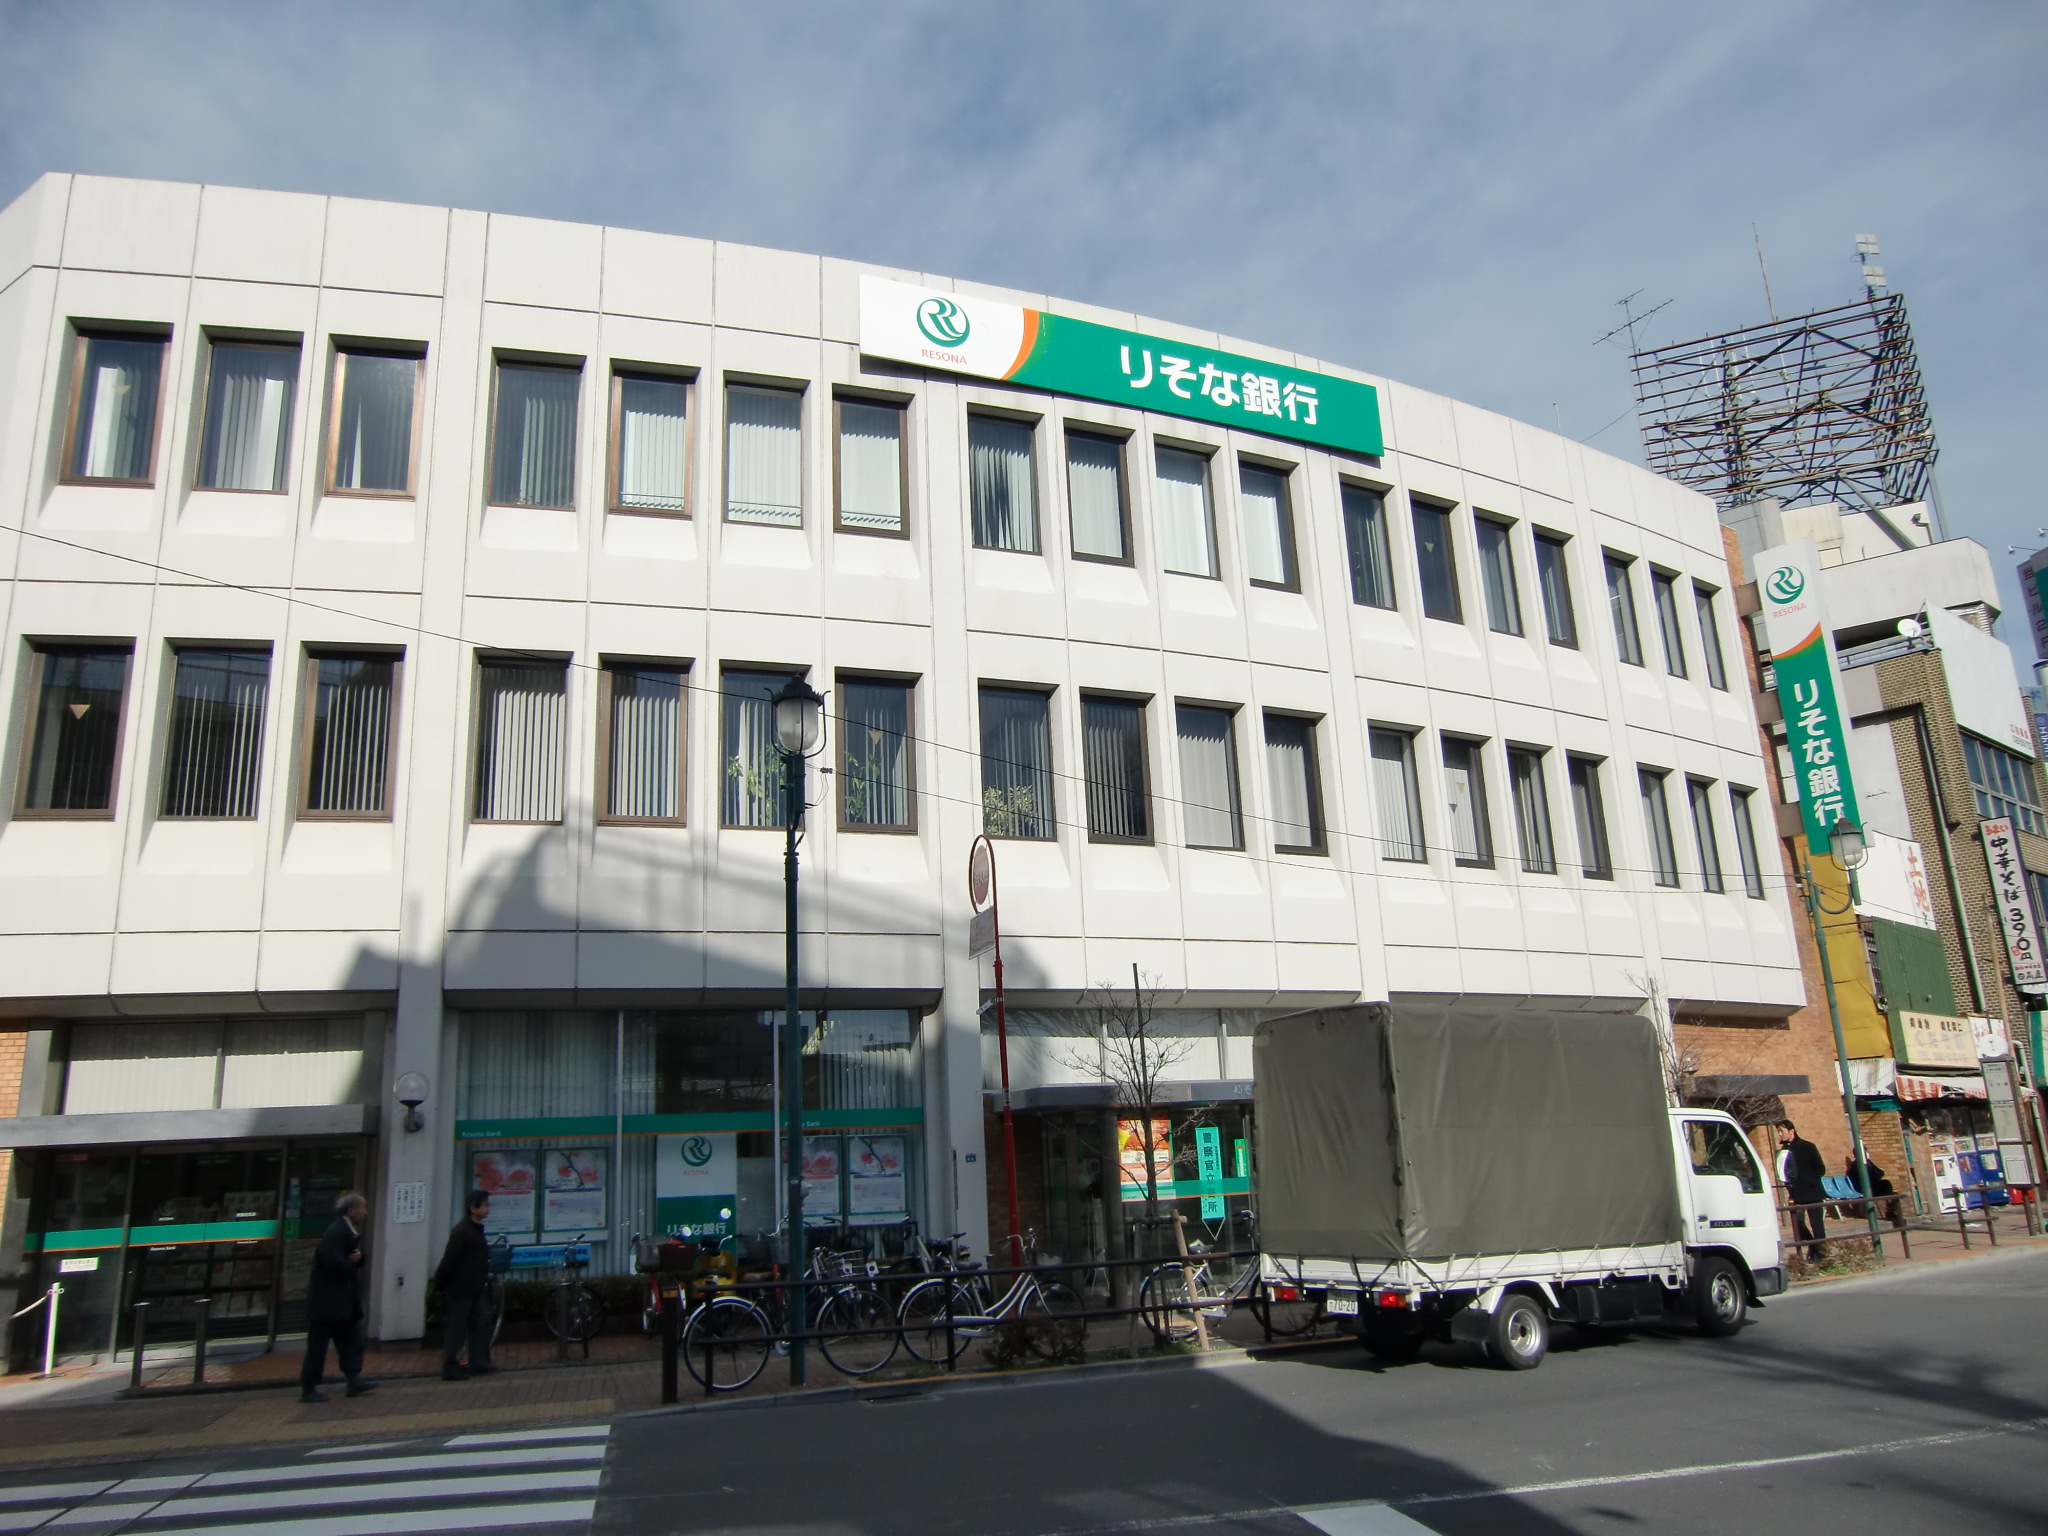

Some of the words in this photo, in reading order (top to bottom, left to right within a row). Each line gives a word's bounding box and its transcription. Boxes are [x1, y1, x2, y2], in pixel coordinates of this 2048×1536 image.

[921, 348, 968, 365] RESONA
[1119, 344, 1319, 426] りそな銀行
[1773, 602, 1807, 619] RESONA
[1793, 678, 1845, 827] りそな銀行
